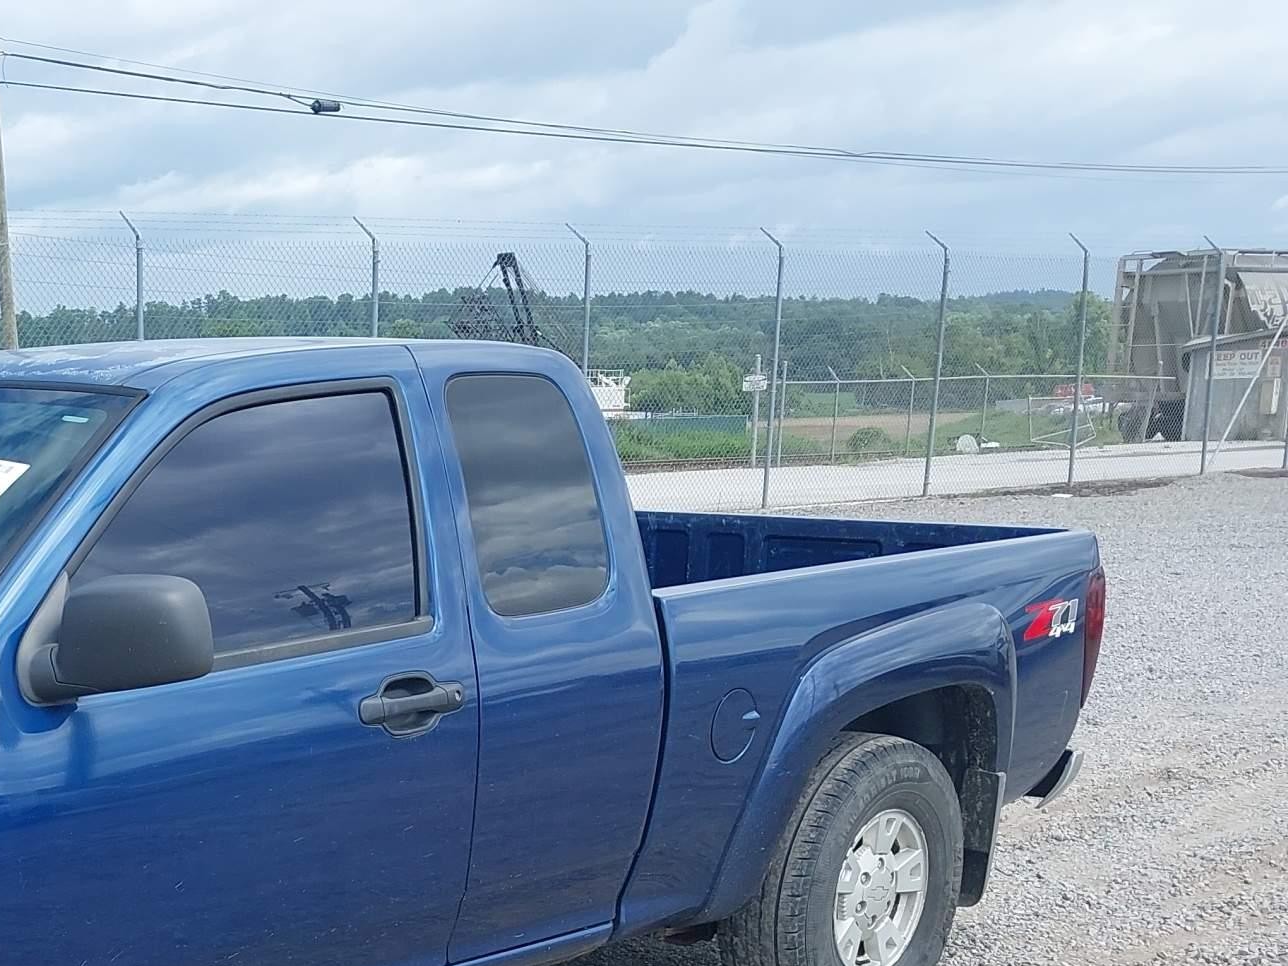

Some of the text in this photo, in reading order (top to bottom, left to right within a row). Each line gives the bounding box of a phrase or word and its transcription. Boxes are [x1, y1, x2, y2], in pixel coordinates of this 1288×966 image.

[1215, 352, 1260, 361] EEP OUT
[1024, 598, 1079, 641] Z71
